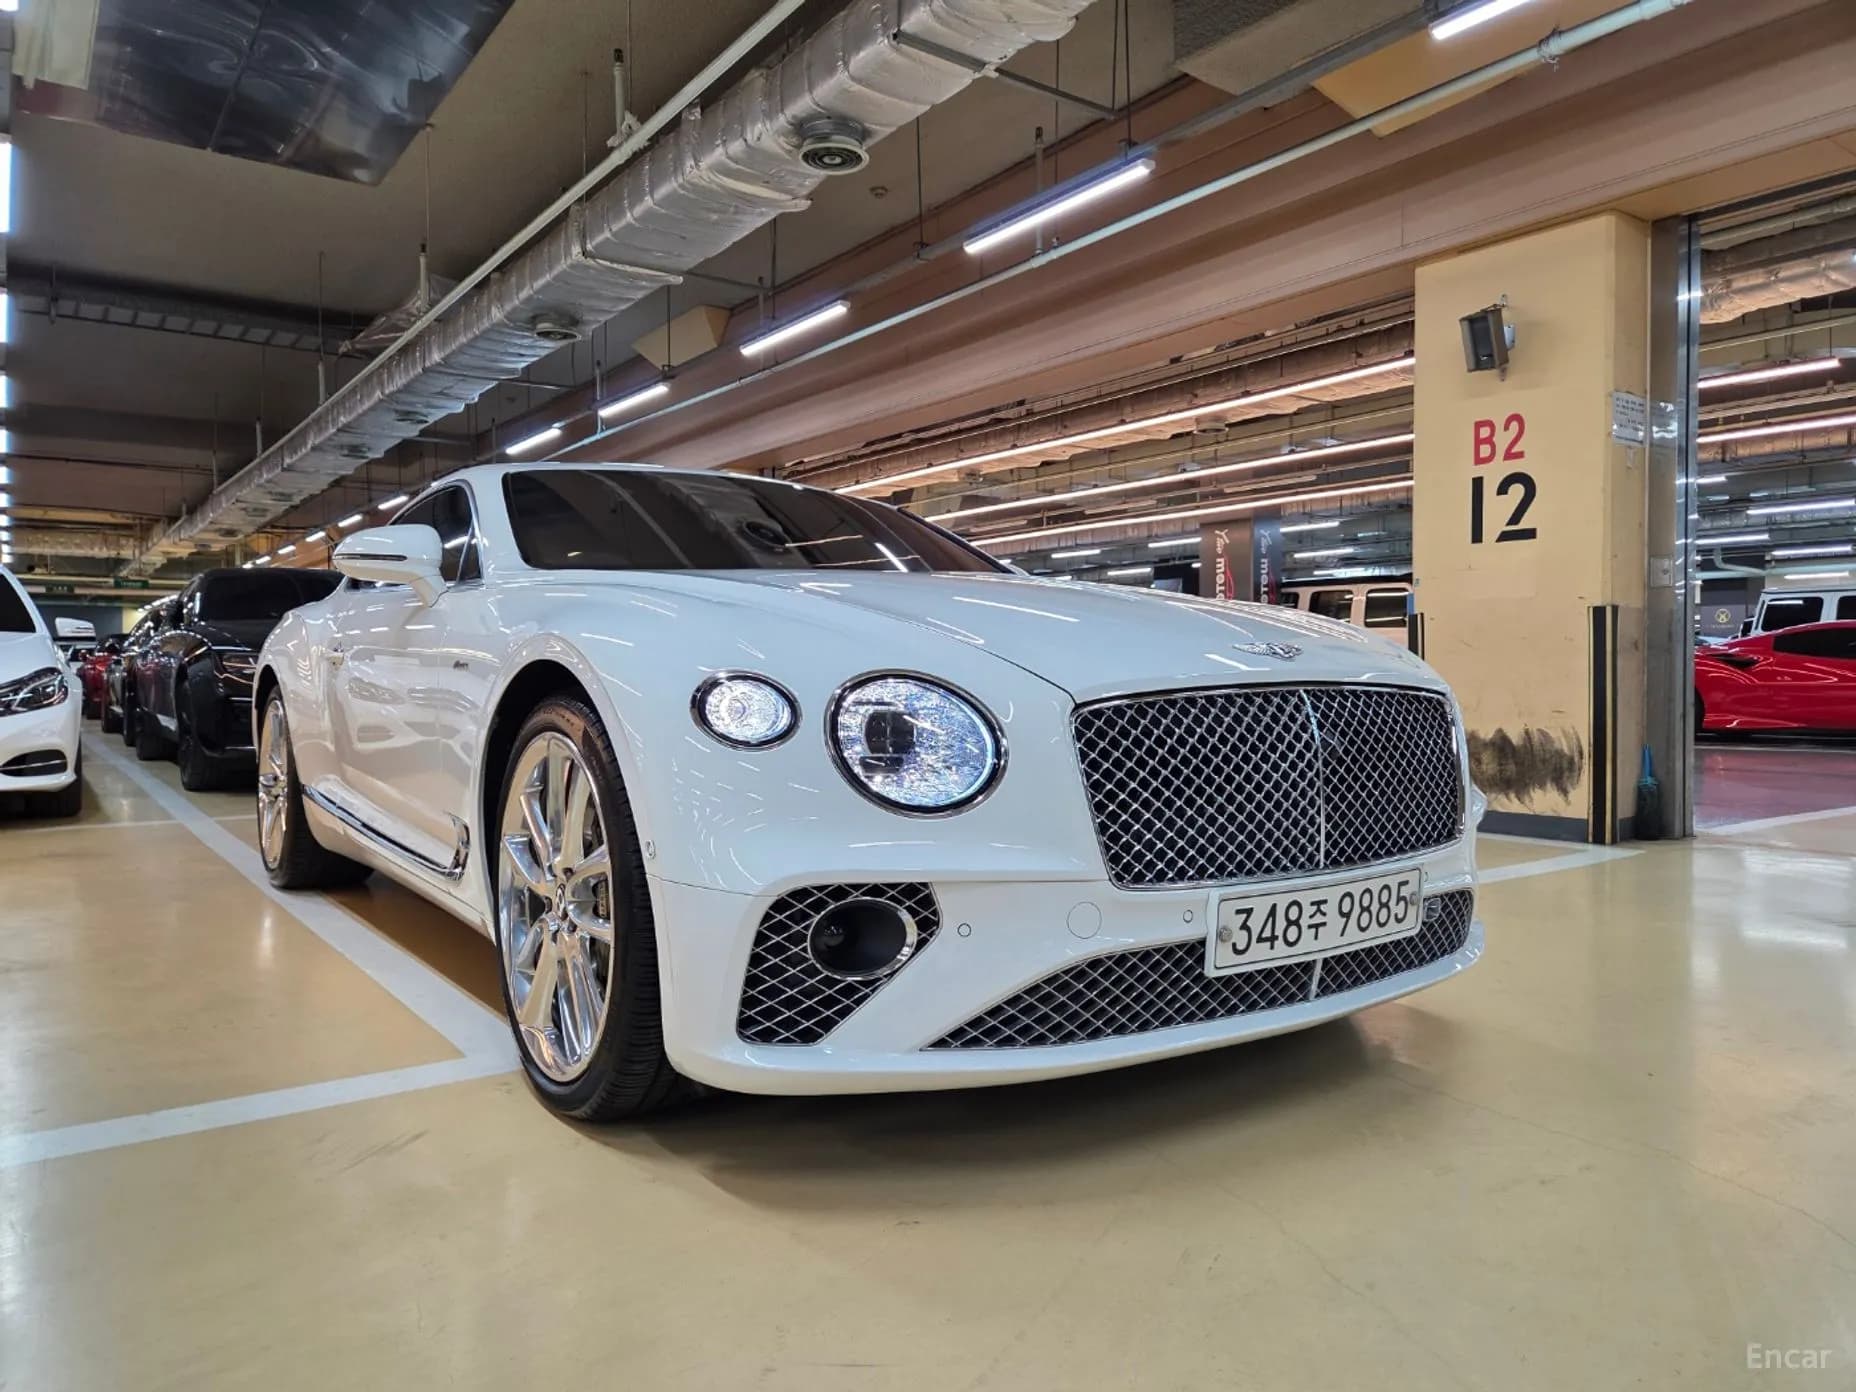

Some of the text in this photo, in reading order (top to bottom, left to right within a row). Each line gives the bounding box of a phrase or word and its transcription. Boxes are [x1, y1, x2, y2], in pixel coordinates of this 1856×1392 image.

[1473, 412, 1526, 466] B2
[1471, 471, 1537, 544] 12
[1231, 879, 1410, 956] 348주 9885
